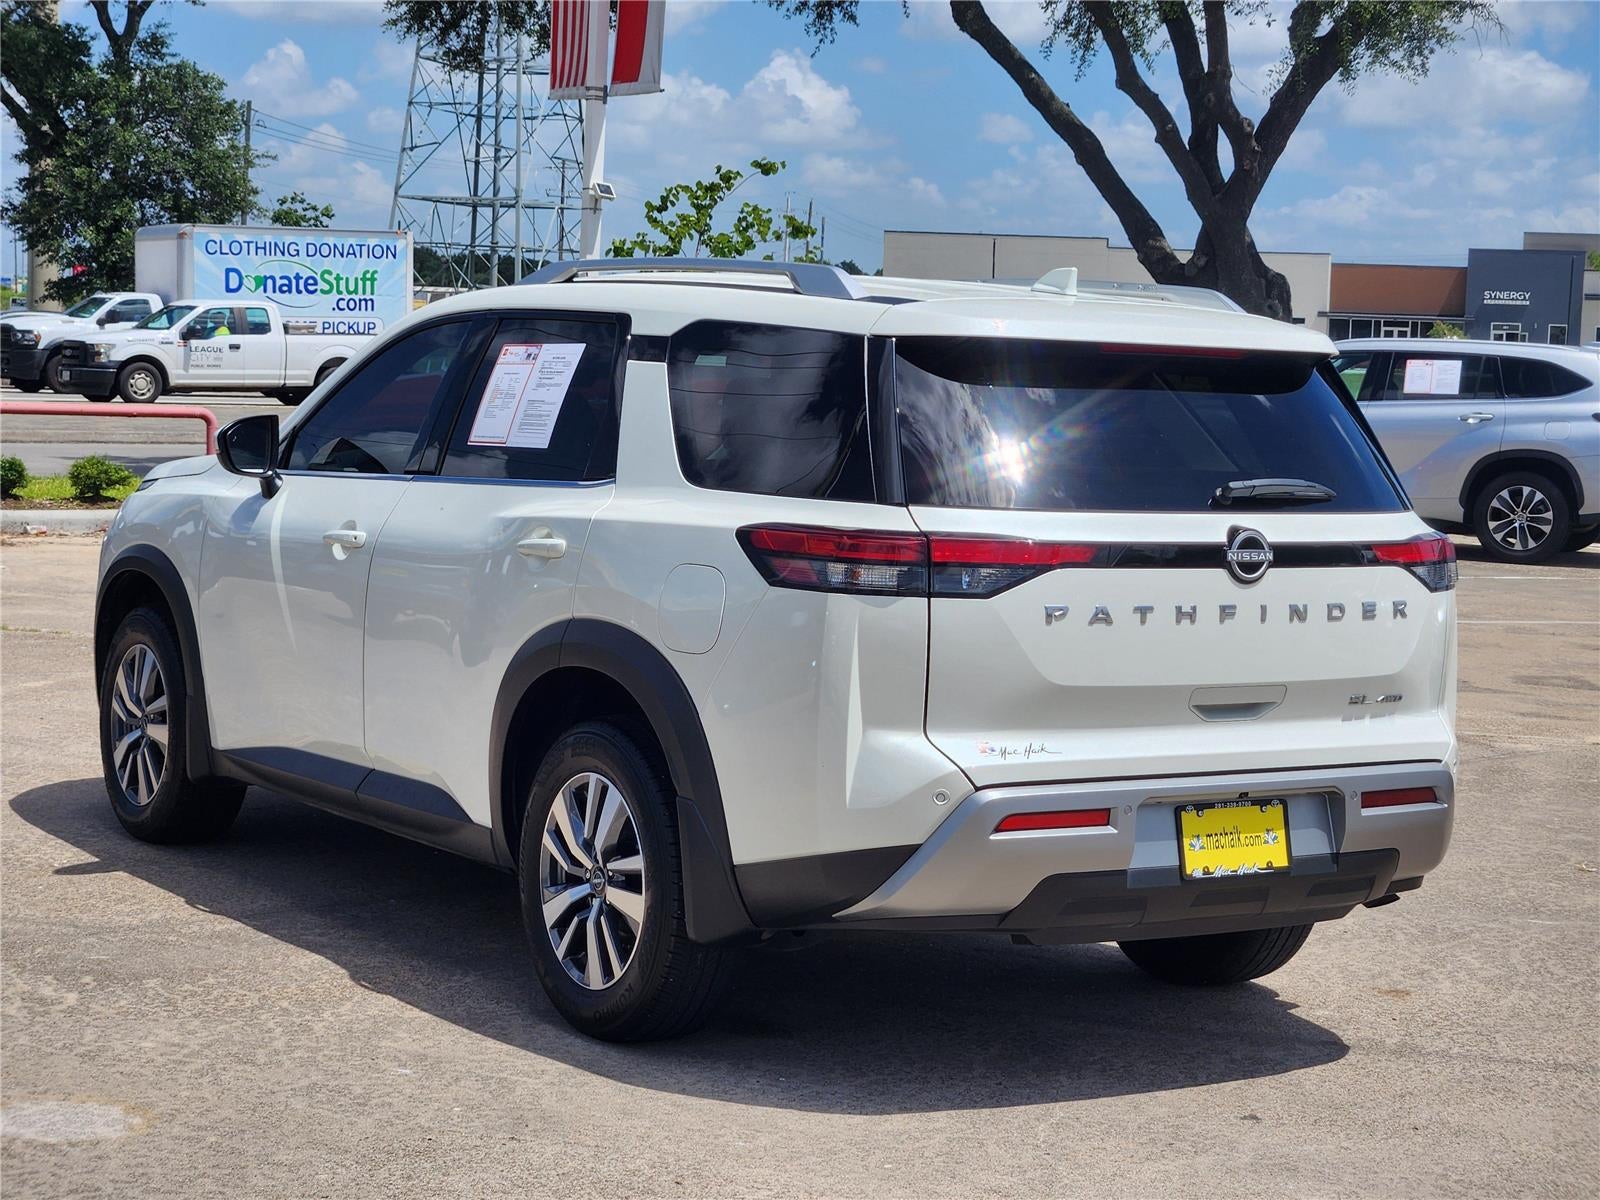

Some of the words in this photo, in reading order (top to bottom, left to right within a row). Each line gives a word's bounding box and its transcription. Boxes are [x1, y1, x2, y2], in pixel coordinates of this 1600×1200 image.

[205, 239, 300, 257] CLOTHING
[305, 242, 397, 259] DONATION
[1483, 290, 1531, 300] SYNERGY
[332, 296, 375, 312] .com
[322, 320, 376, 335] PICKUP
[190, 345, 224, 353] LEAGUE
[1228, 552, 1273, 560] NISSAN
[1044, 600, 1408, 626] PATHFINDER
[1206, 826, 1263, 850] machaik.com
